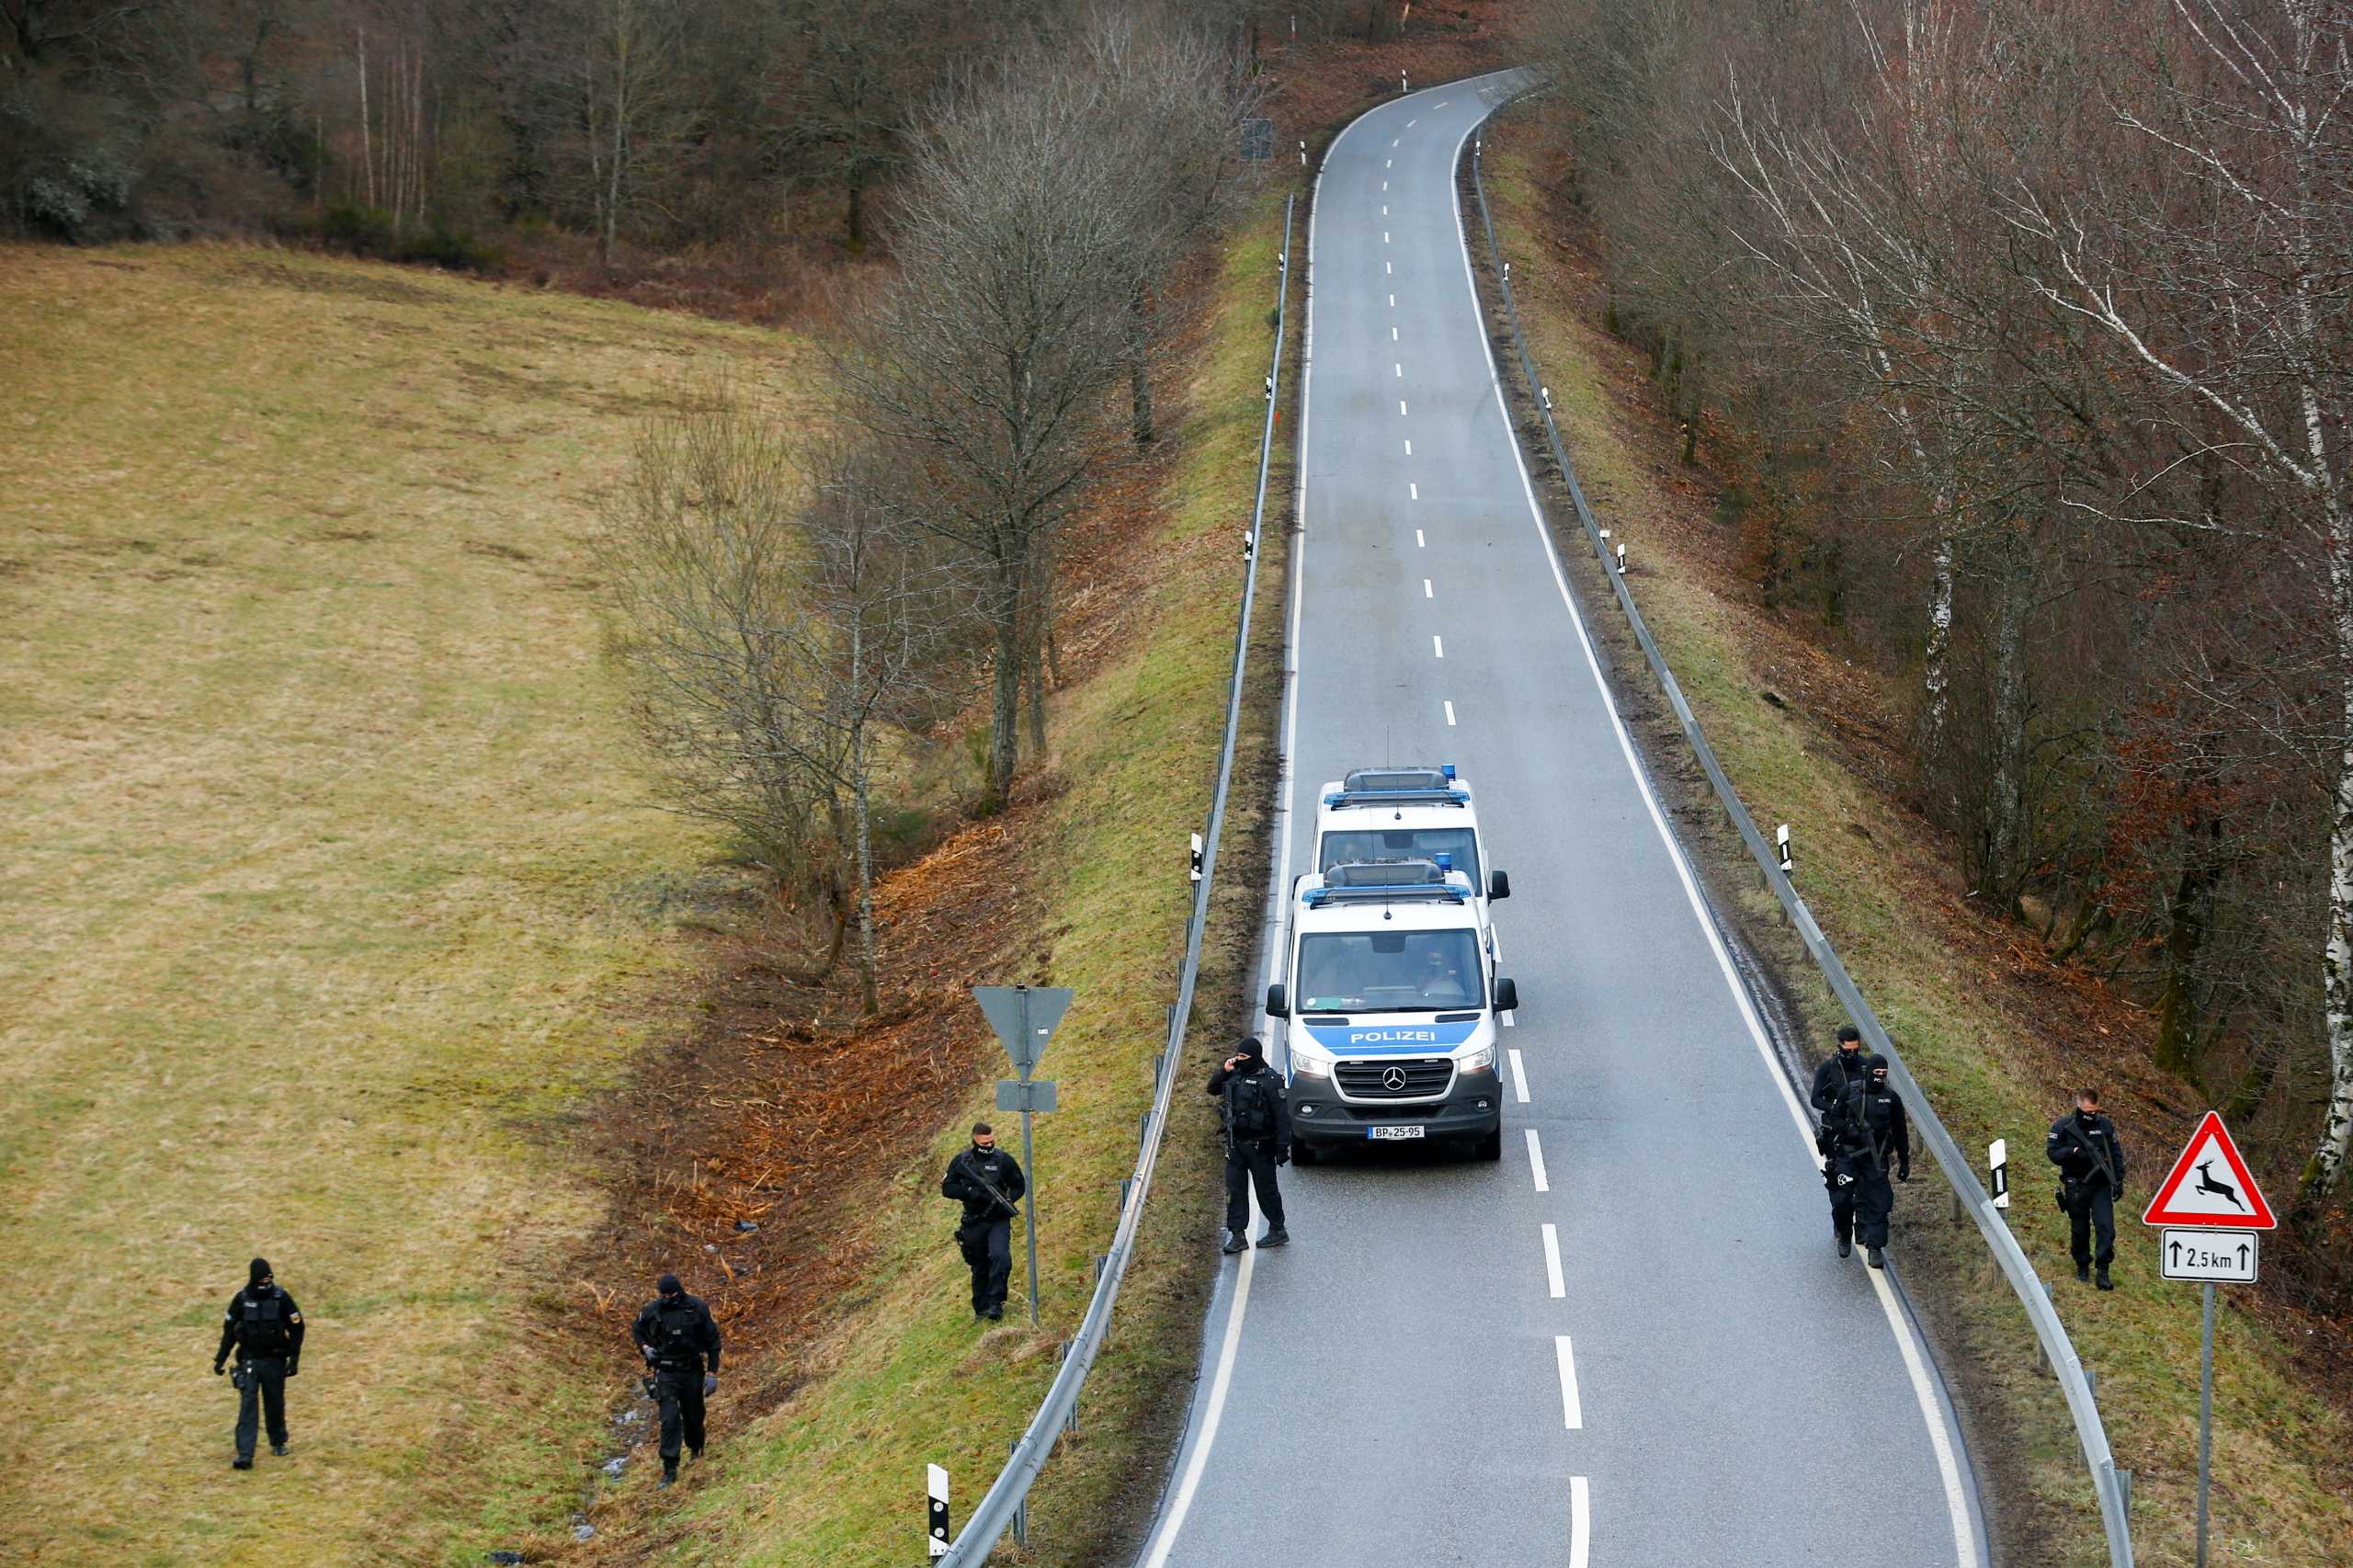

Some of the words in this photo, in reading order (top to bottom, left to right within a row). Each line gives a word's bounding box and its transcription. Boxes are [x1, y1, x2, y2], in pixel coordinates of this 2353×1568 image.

[1351, 1030, 1435, 1043] POLIZEI
[1375, 1128, 1389, 1138] BP
[1393, 1127, 1420, 1137] 25-95
[2211, 1252, 2232, 1268] km
